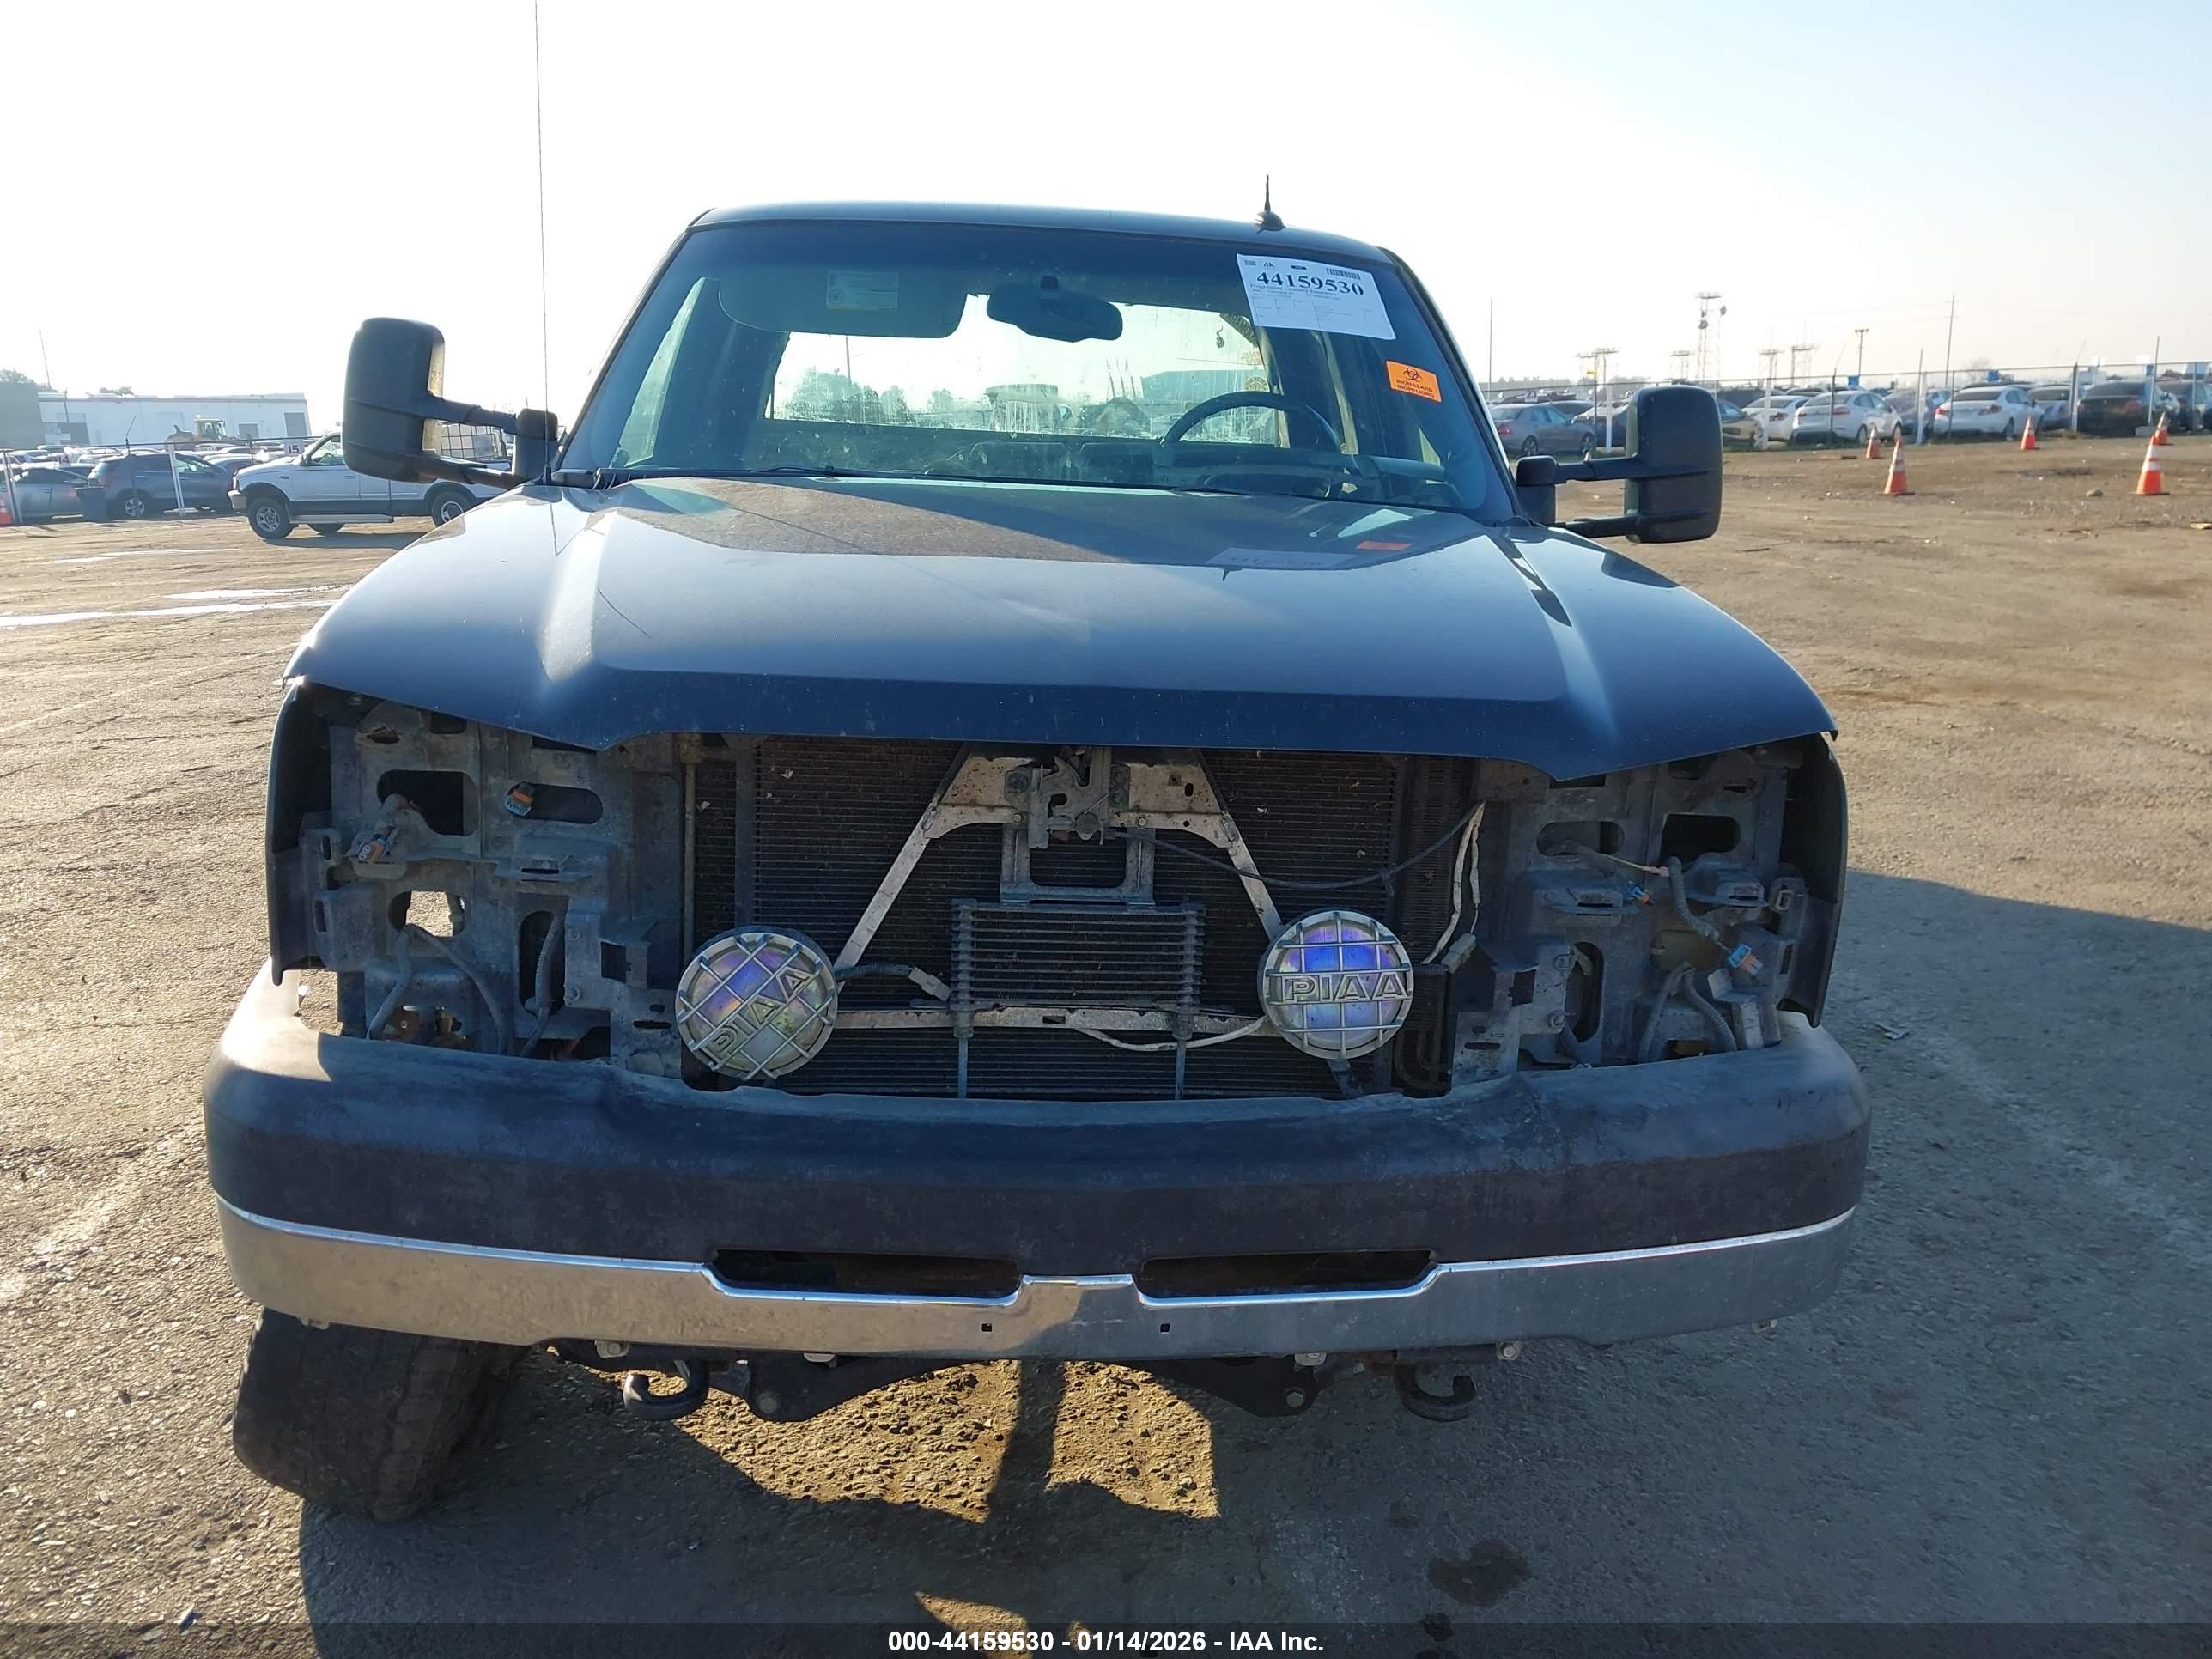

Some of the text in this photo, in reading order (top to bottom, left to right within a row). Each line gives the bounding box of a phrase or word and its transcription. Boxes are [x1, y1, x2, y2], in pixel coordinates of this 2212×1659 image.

[1256, 271, 1364, 296] 44159530
[1396, 379, 1433, 392] BIOHAZARD
[288, 445, 300, 454] 15
[1281, 972, 1413, 1004] PIAA
[700, 966, 814, 1069] PIAA
